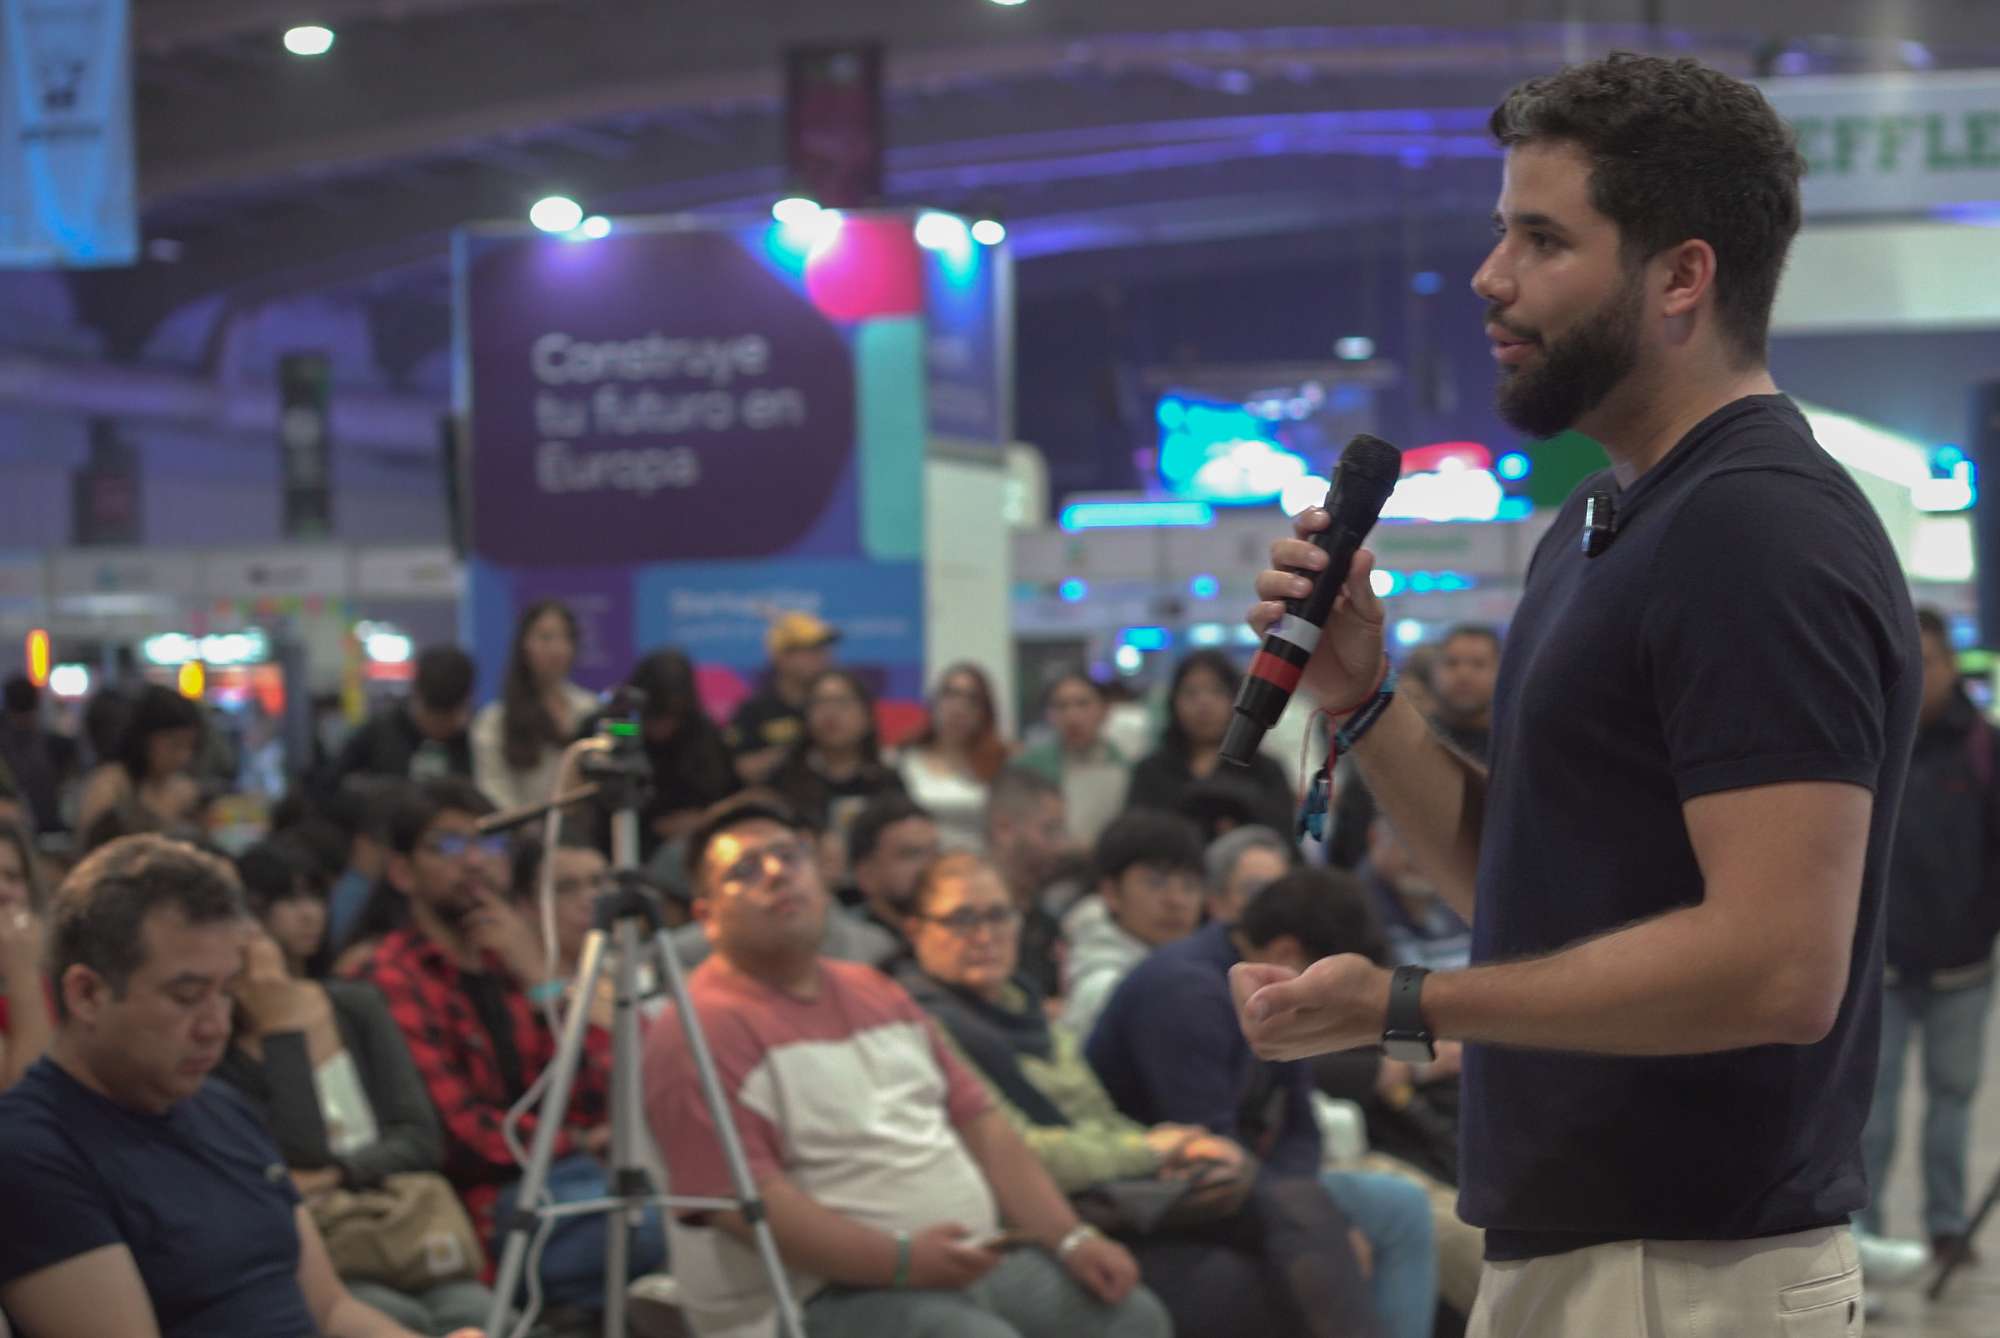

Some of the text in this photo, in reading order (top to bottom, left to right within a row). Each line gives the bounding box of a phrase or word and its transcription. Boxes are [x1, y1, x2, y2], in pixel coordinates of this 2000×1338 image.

[532, 333, 768, 386] Construye
[536, 383, 805, 438] tu futuro en
[536, 441, 698, 496] Europa
